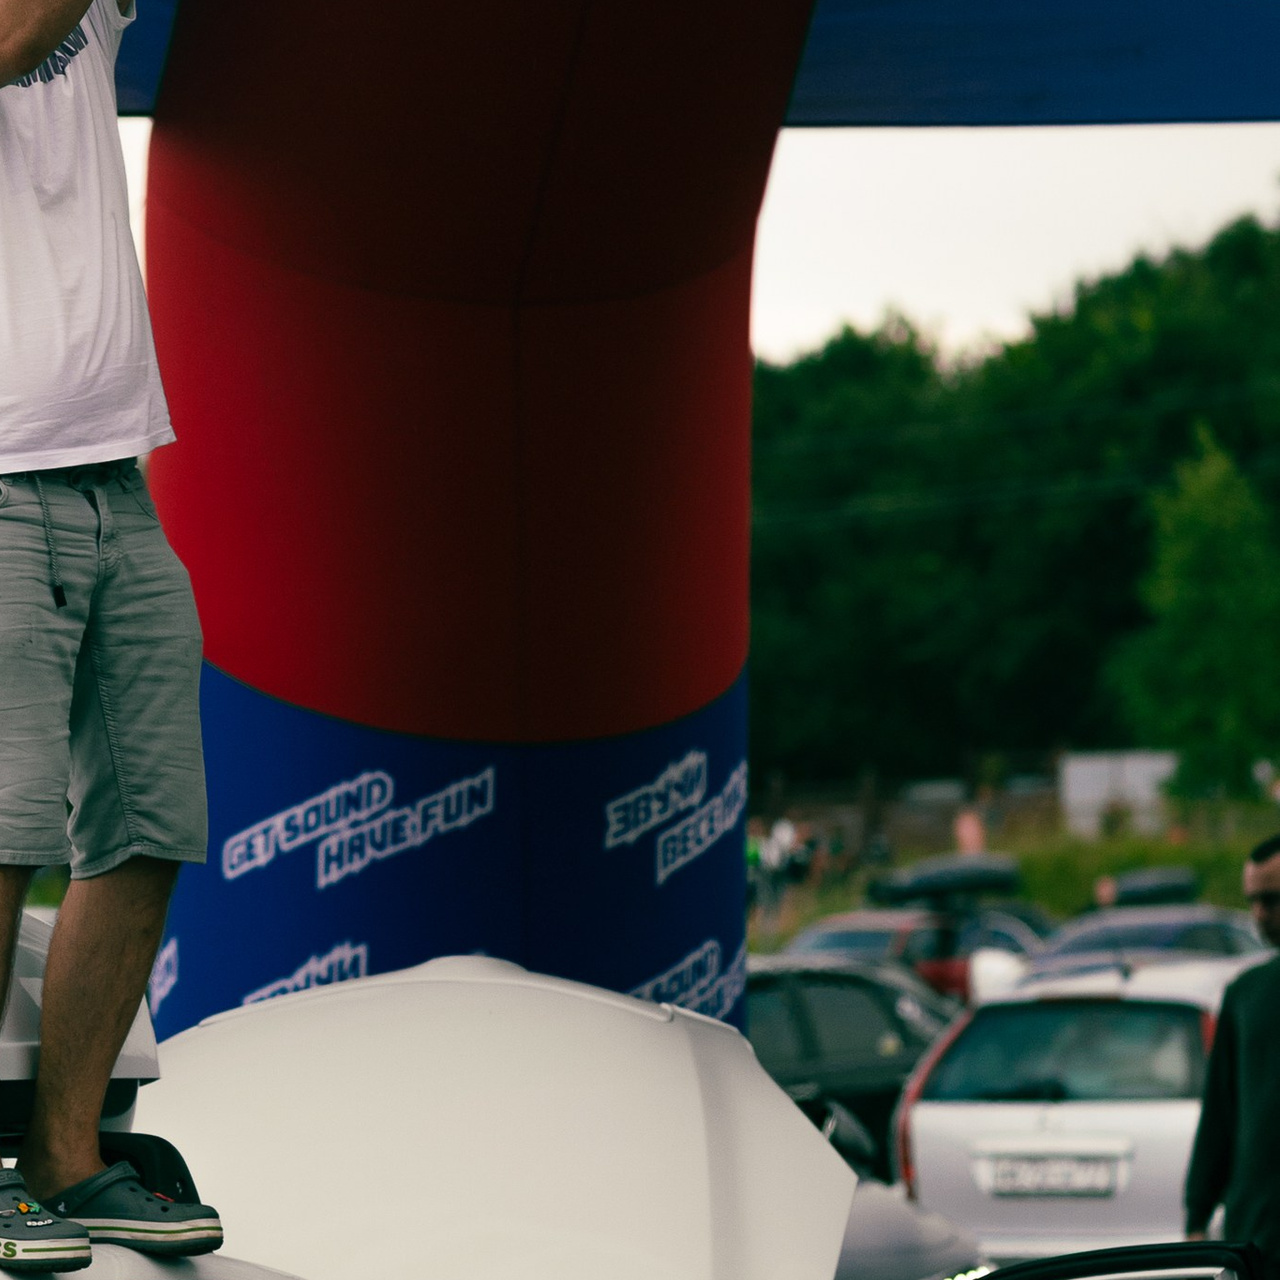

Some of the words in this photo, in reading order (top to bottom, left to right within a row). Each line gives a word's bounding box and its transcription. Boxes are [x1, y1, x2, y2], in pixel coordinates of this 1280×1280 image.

[224, 823, 275, 874] GET
[278, 772, 391, 847] SOUND
[321, 811, 411, 880] HAVE
[419, 773, 492, 839] FUN
